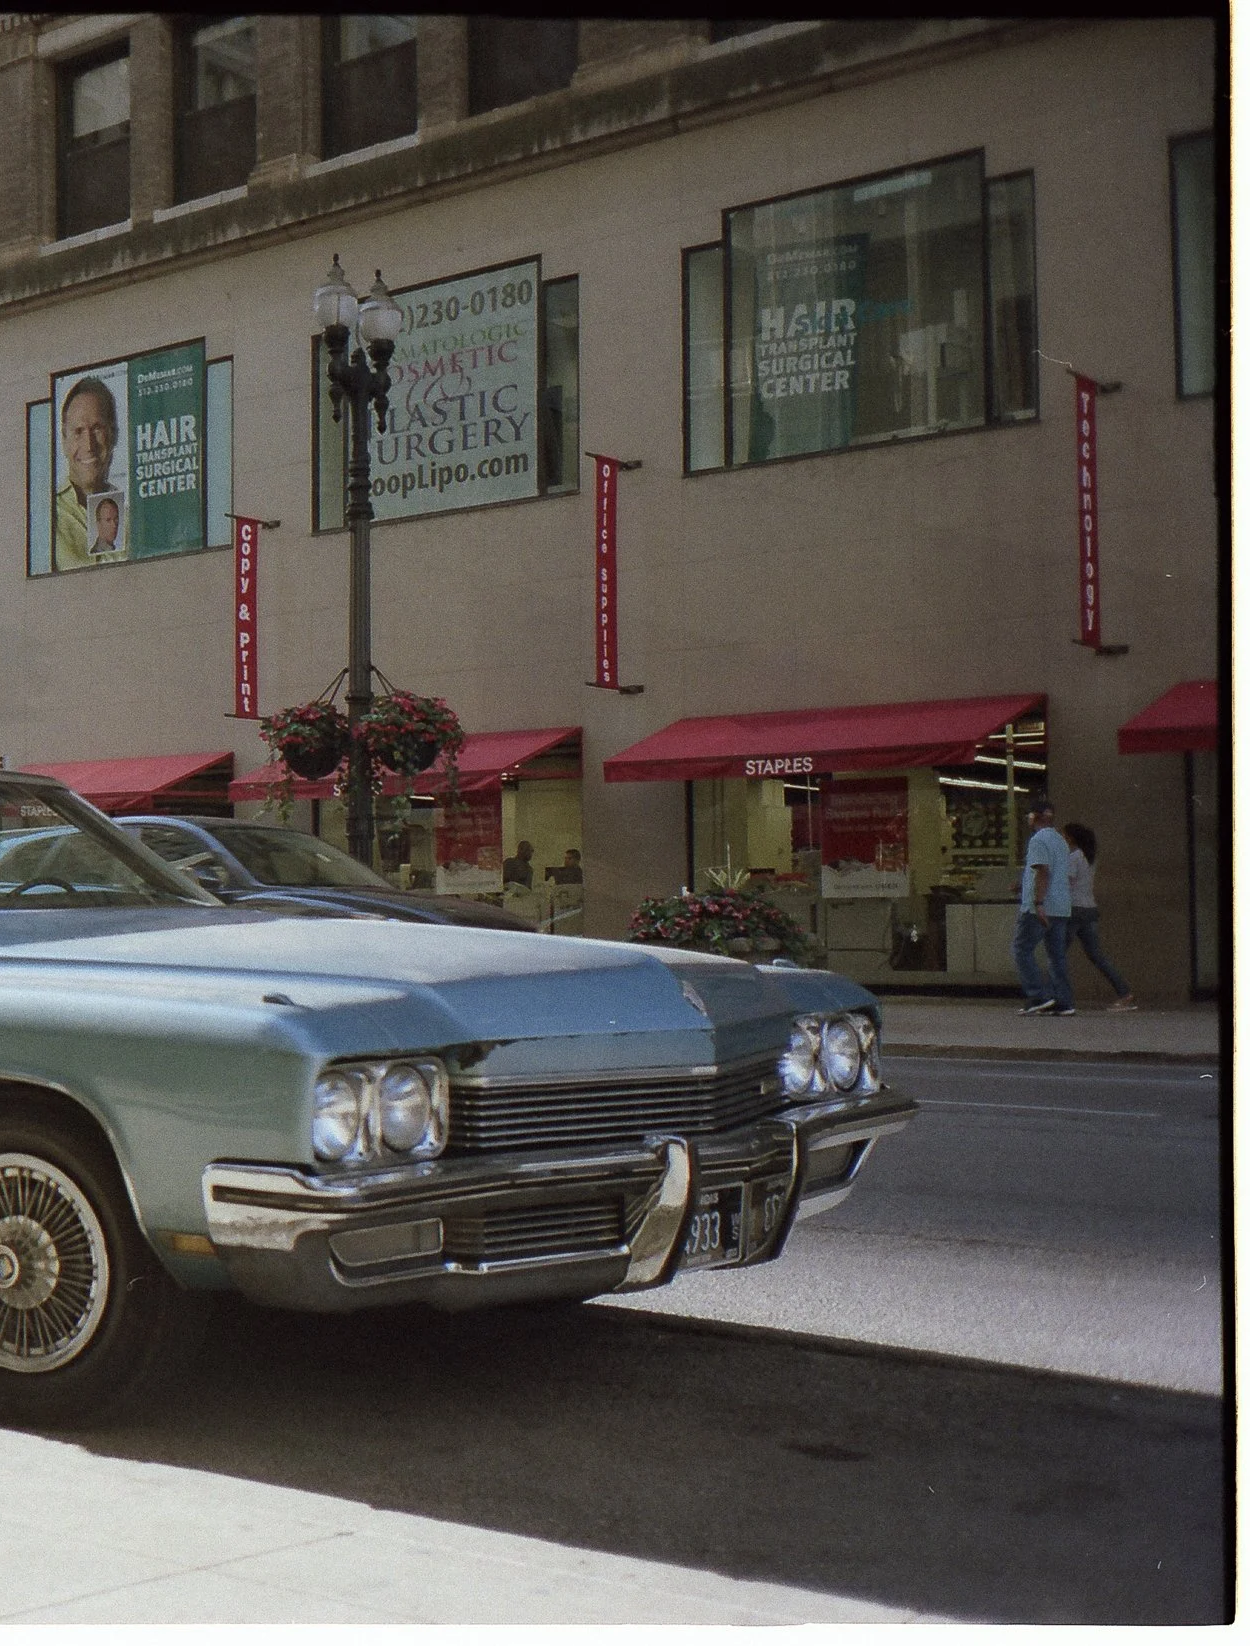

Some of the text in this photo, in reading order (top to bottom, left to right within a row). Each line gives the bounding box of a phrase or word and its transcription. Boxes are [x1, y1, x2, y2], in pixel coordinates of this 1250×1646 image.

[399, 279, 532, 335] )230-0180
[760, 298, 856, 341] HAIR
[393, 340, 517, 383] OSMETIC
[755, 332, 857, 357] TRANSPLANT
[757, 349, 856, 377] SURGICAL
[761, 369, 850, 399] CENTER
[389, 384, 517, 433] LASTIC
[136, 415, 197, 451] HAIR
[136, 442, 198, 465] TRANSPLANT
[377, 412, 530, 465] URGERY
[136, 456, 198, 480] SURGICAL
[138, 473, 196, 498] CENTER
[368, 453, 529, 499] oopLipo.com
[1081, 392, 1094, 630] Technology
[601, 464, 611, 682] Office Supplies
[239, 524, 252, 713] Copy & Print
[745, 757, 813, 775] STAPLES
